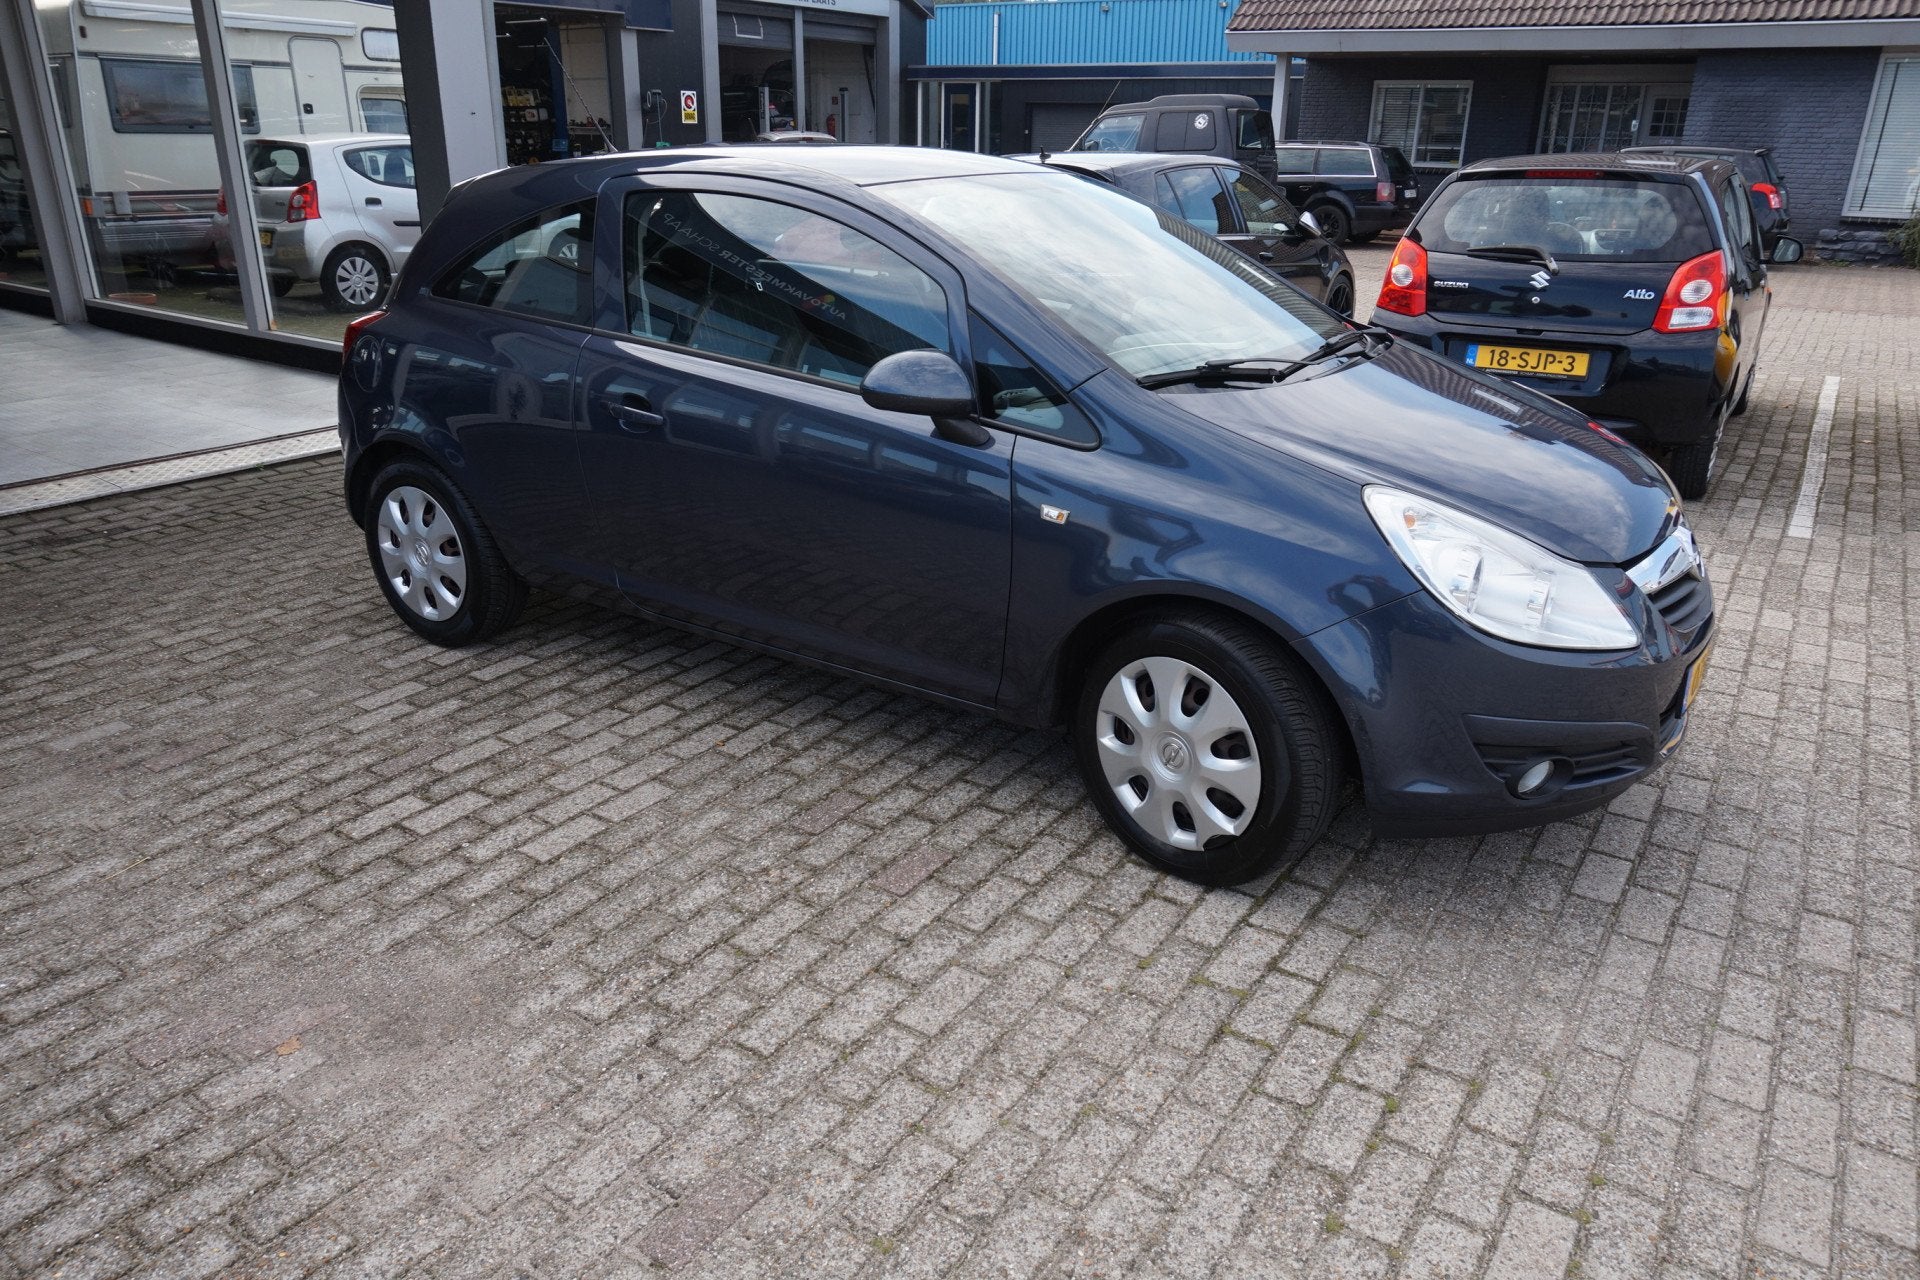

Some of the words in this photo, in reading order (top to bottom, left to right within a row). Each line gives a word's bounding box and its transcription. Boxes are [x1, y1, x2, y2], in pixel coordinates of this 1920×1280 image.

[1433, 280, 1469, 289] SUZUKI
[1622, 288, 1655, 300] Alto
[1489, 349, 1576, 373] 18-SJP-3
